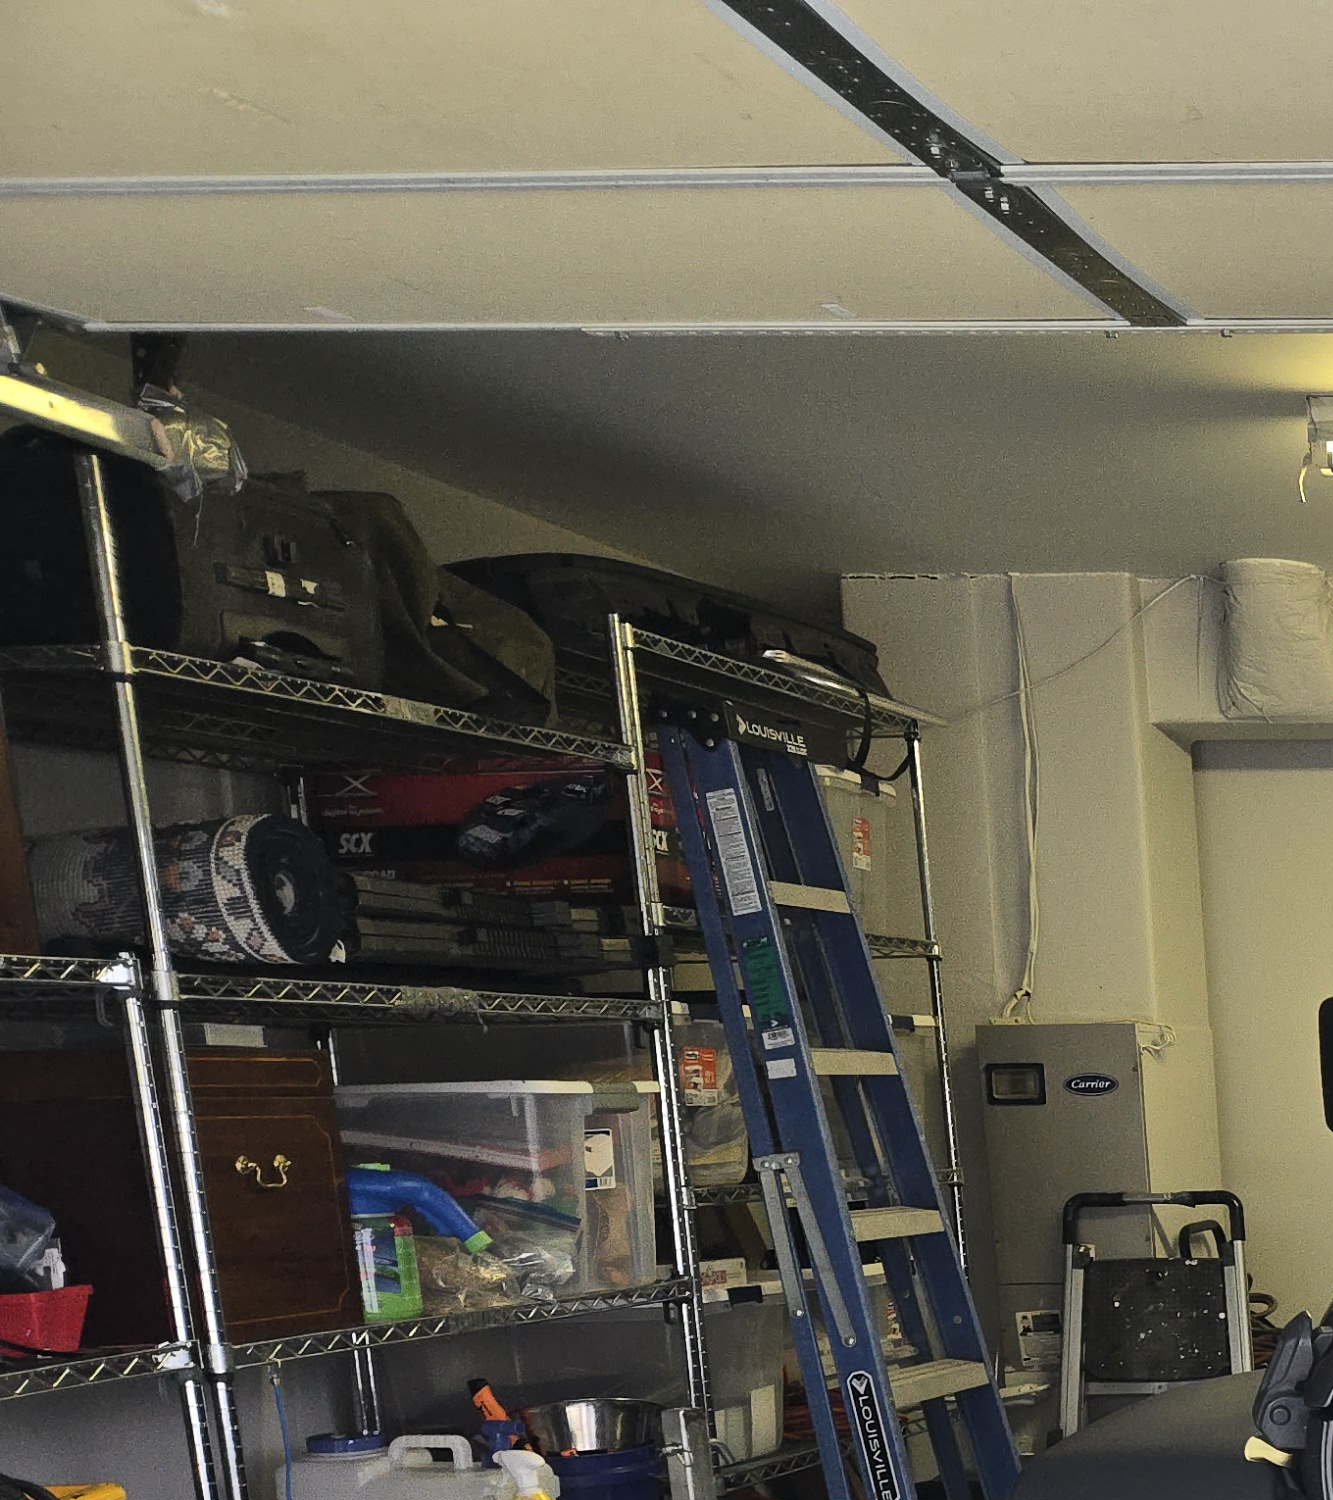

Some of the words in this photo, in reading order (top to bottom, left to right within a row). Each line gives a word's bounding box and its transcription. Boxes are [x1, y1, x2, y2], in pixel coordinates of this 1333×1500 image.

[745, 720, 807, 748] LOUISVILLE
[338, 832, 373, 854] SCX
[1071, 1079, 1111, 1089] Carrier
